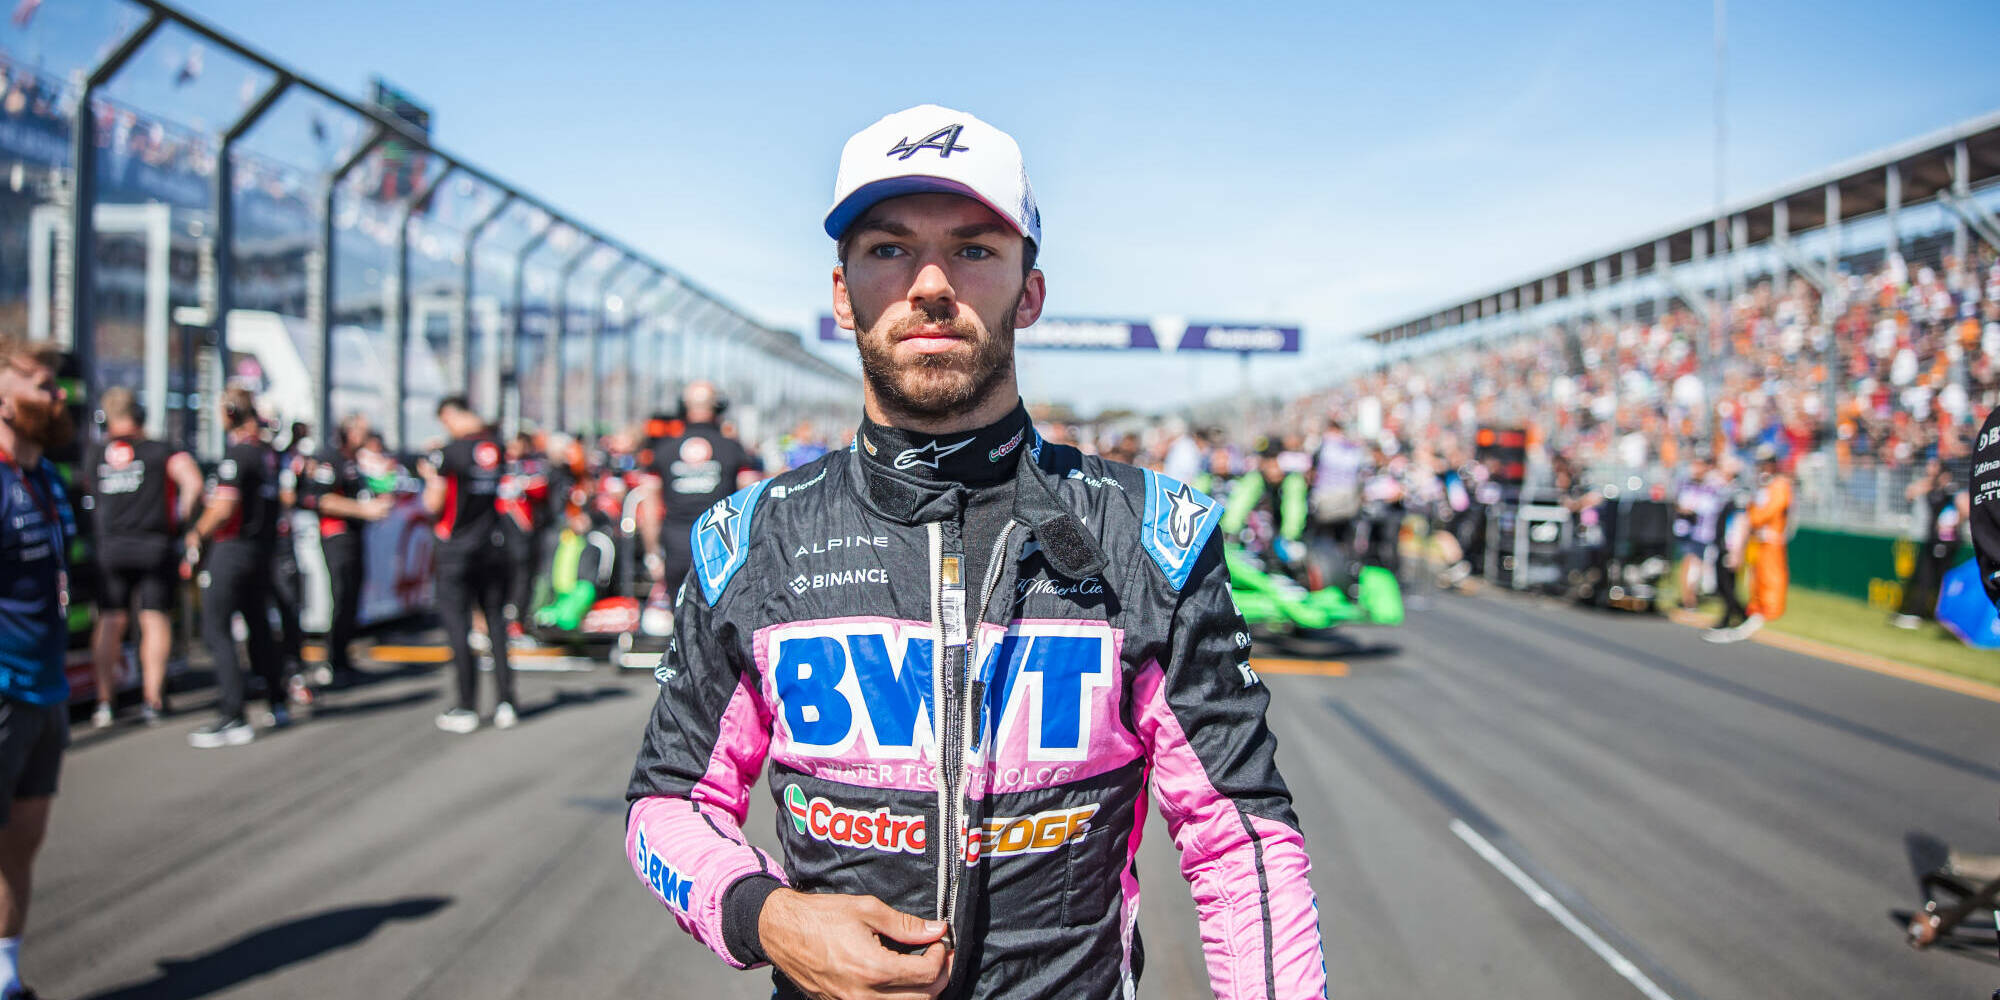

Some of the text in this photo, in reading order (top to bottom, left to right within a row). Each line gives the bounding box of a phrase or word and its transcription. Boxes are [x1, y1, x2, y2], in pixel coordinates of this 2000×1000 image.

[794, 535, 889, 559] ALPINE
[812, 568, 889, 590] BINANCE
[773, 630, 1106, 753] BWT
